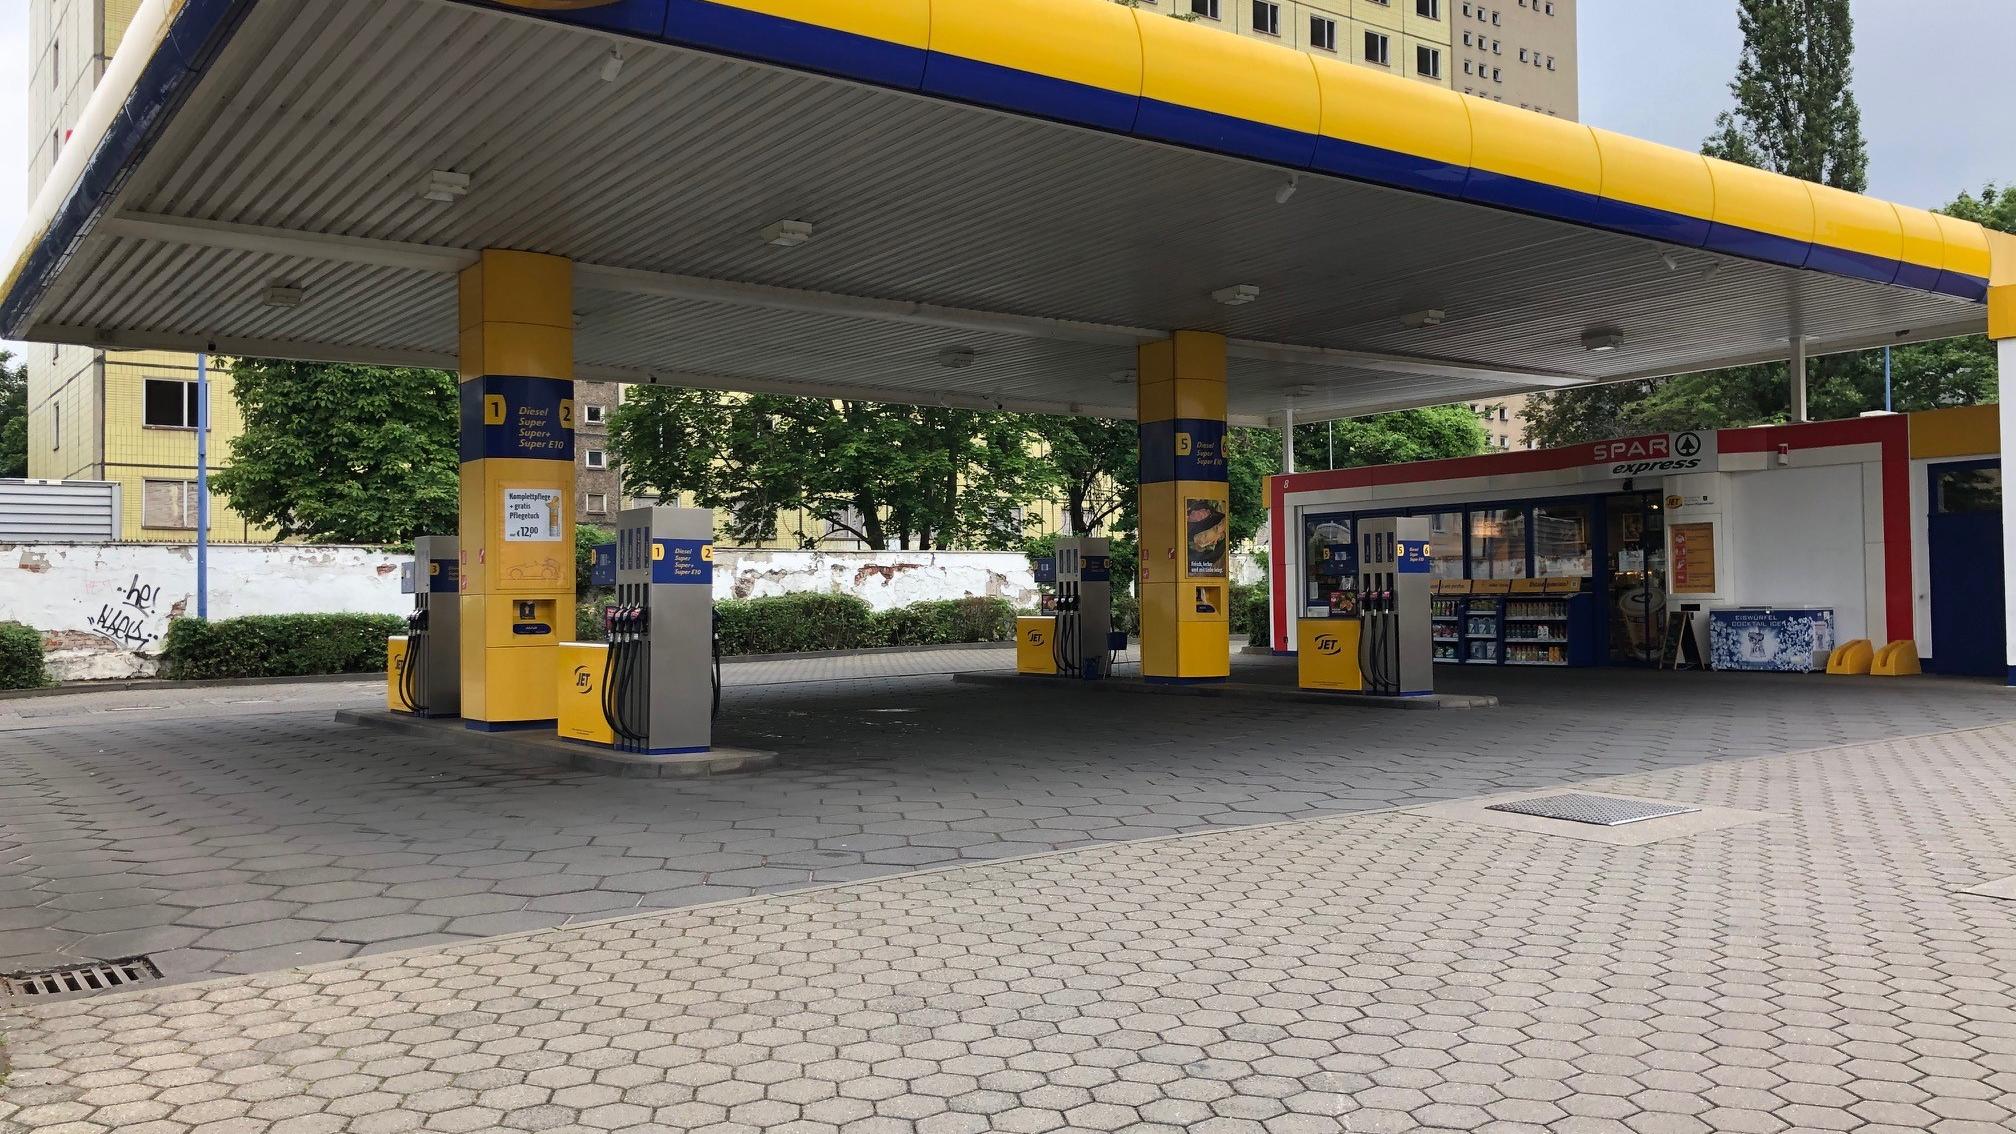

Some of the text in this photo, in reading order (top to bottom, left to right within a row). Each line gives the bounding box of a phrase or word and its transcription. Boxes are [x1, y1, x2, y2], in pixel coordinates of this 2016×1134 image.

[491, 402, 499, 417] 1
[518, 406, 549, 416] Diesel
[563, 406, 571, 421] 2
[518, 417, 547, 427] Super
[518, 428, 551, 438] Super+
[518, 439, 564, 449] Super E10
[1181, 439, 1188, 449] 5
[1197, 450, 1213, 458] Super
[1593, 439, 1668, 460] SPAR
[1197, 458, 1213, 467] Super
[1612, 459, 1702, 475] express
[1283, 479, 1289, 489] 8
[509, 492, 551, 501] Komplettpflege
[514, 503, 531, 511] gratis
[1667, 498, 1680, 506] JET
[509, 512, 540, 520] Pflegetuch
[655, 547, 660, 558] 1
[705, 549, 711, 558] 2
[432, 565, 437, 573] 3
[674, 568, 691, 576] Super
[1030, 633, 1043, 641] JET
[1317, 639, 1338, 650] JET
[576, 672, 590, 687] JET
